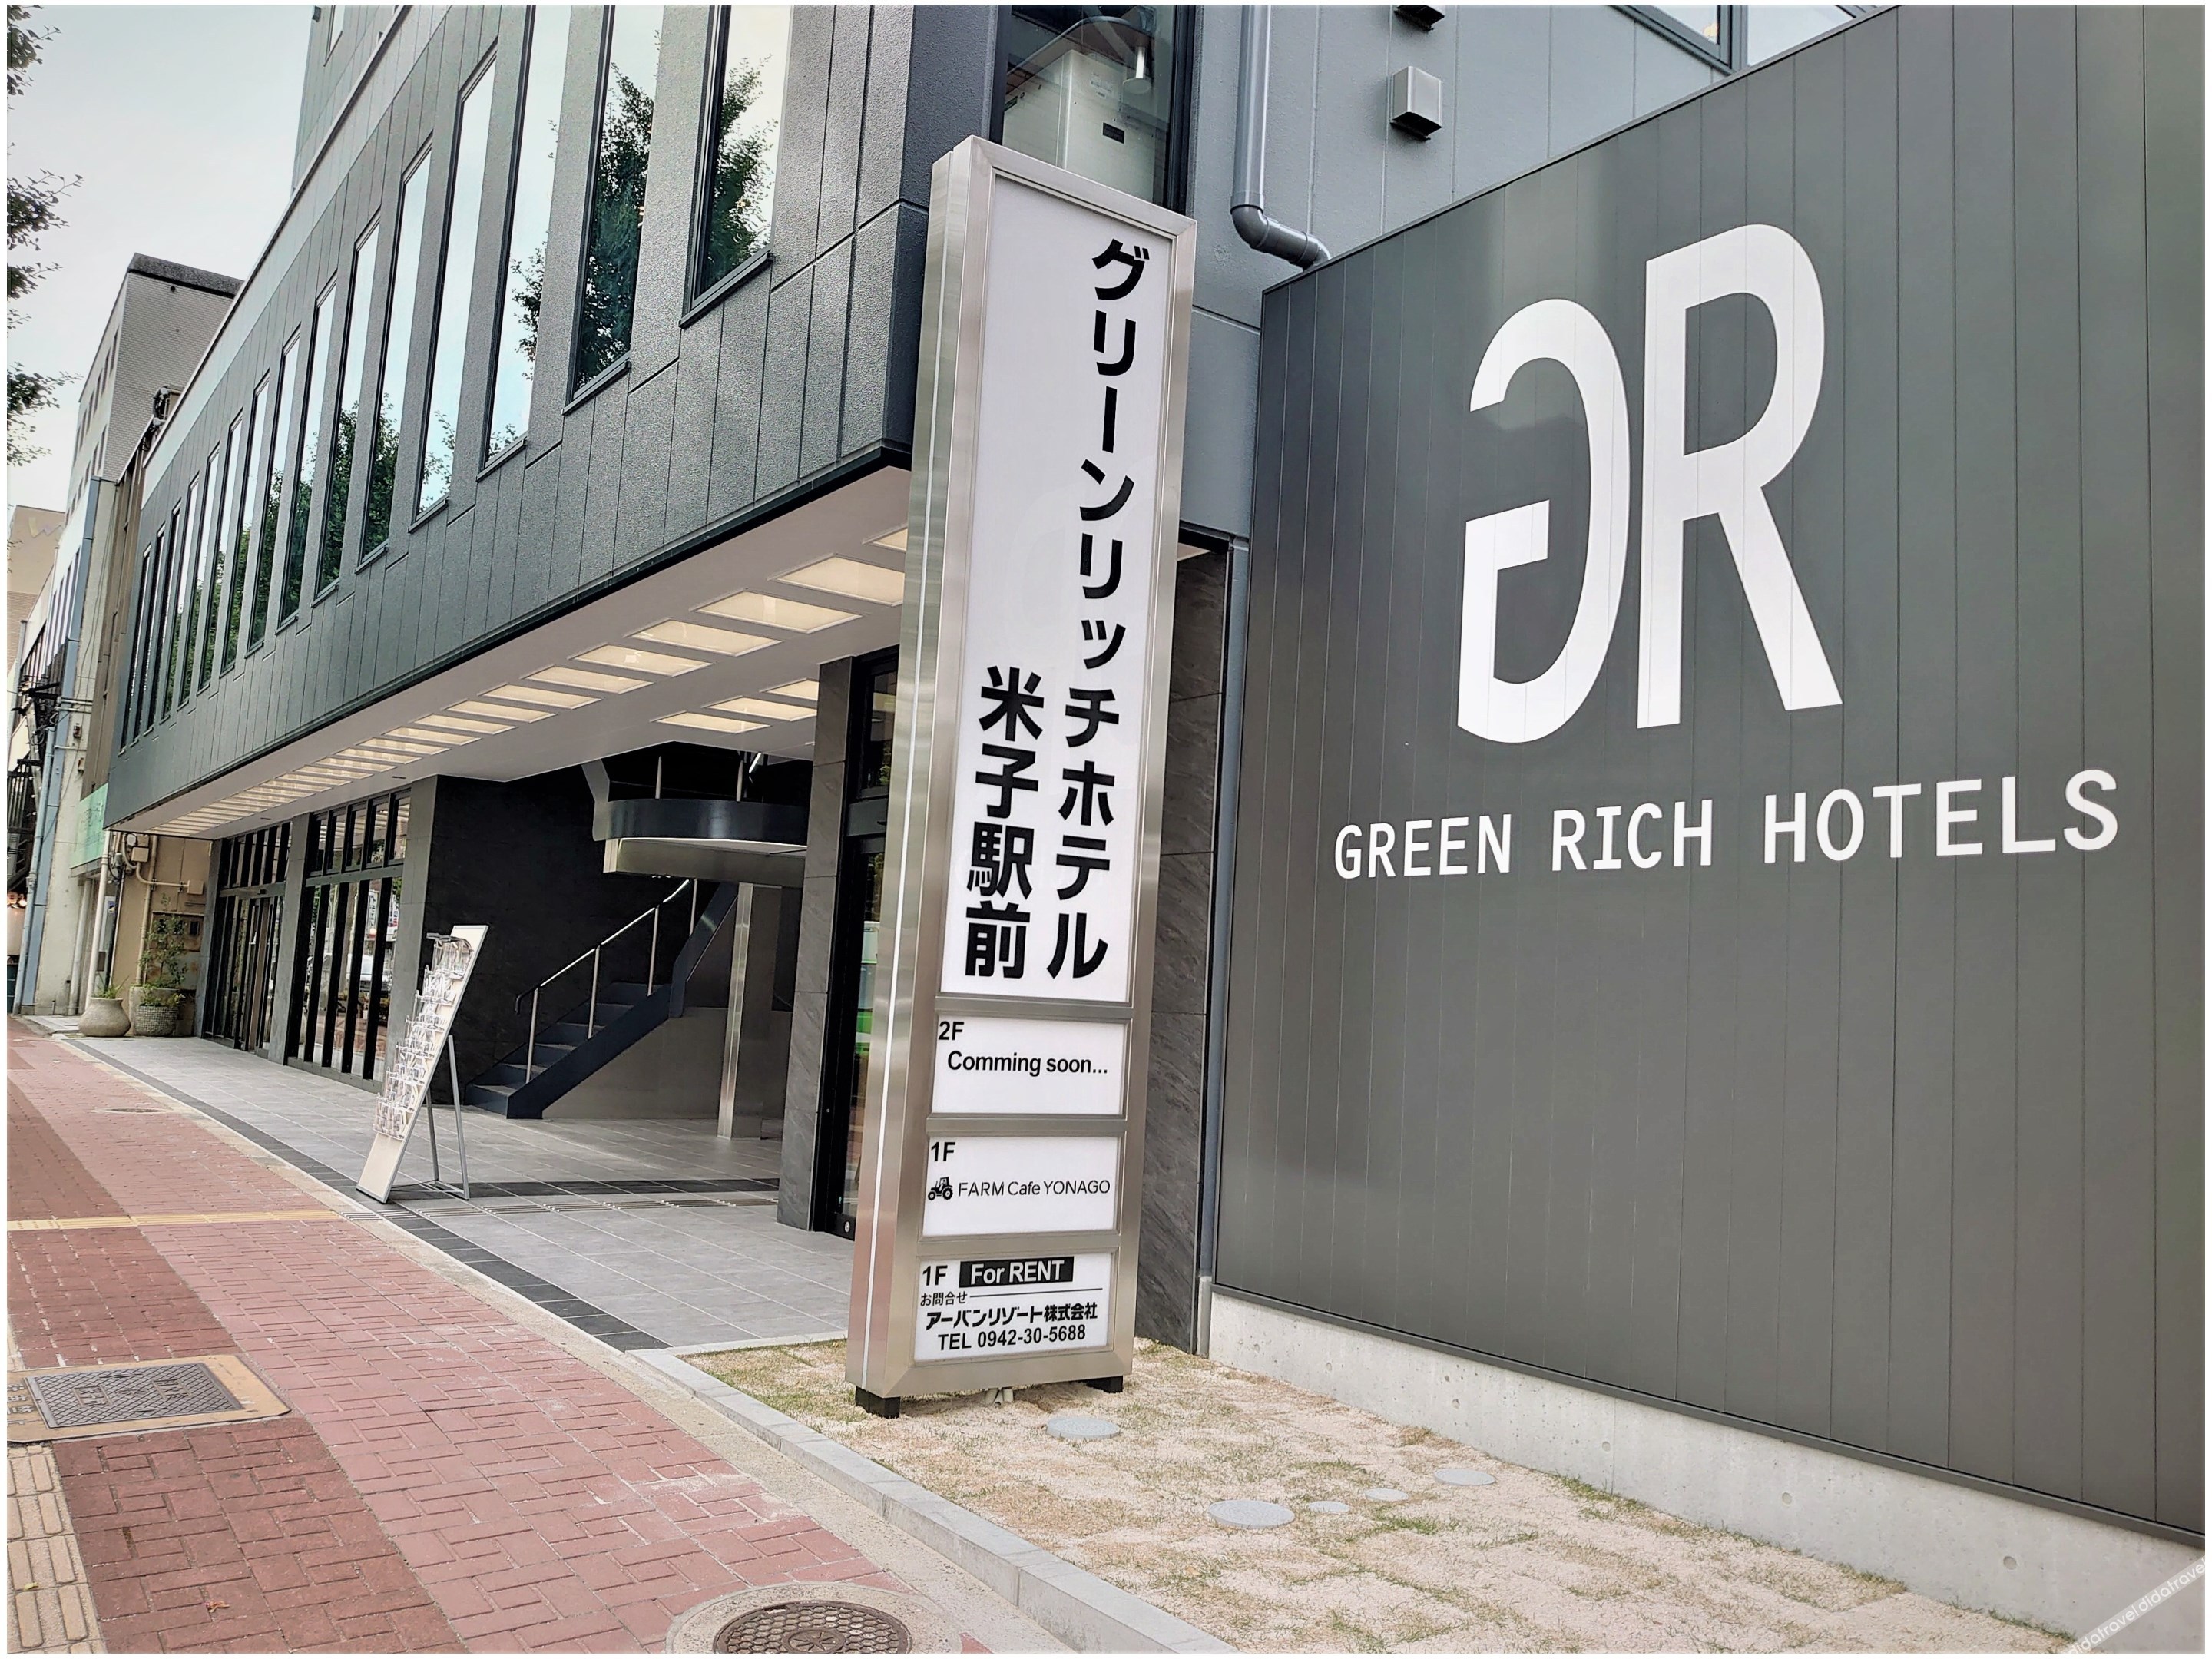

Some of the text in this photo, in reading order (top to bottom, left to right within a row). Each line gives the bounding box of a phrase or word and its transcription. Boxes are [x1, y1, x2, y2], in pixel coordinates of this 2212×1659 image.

[1046, 238, 1150, 979] グリーンリッチホテル
[965, 665, 1045, 979] 米子駅前
[1334, 769, 2118, 879] GREEN RICH HOTELS
[938, 1021, 965, 1041] 2F
[947, 1050, 1108, 1078] Comming soon...
[931, 1141, 956, 1162] 1F
[958, 1179, 1111, 1197] FARM Cafe YONAGO
[922, 1260, 1065, 1286] 1F For RENT
[920, 1290, 969, 1306] お問合せ
[926, 1302, 1098, 1330] アーバンリゾート株式会社
[938, 1324, 1087, 1351] TEL 0942-30-5688
